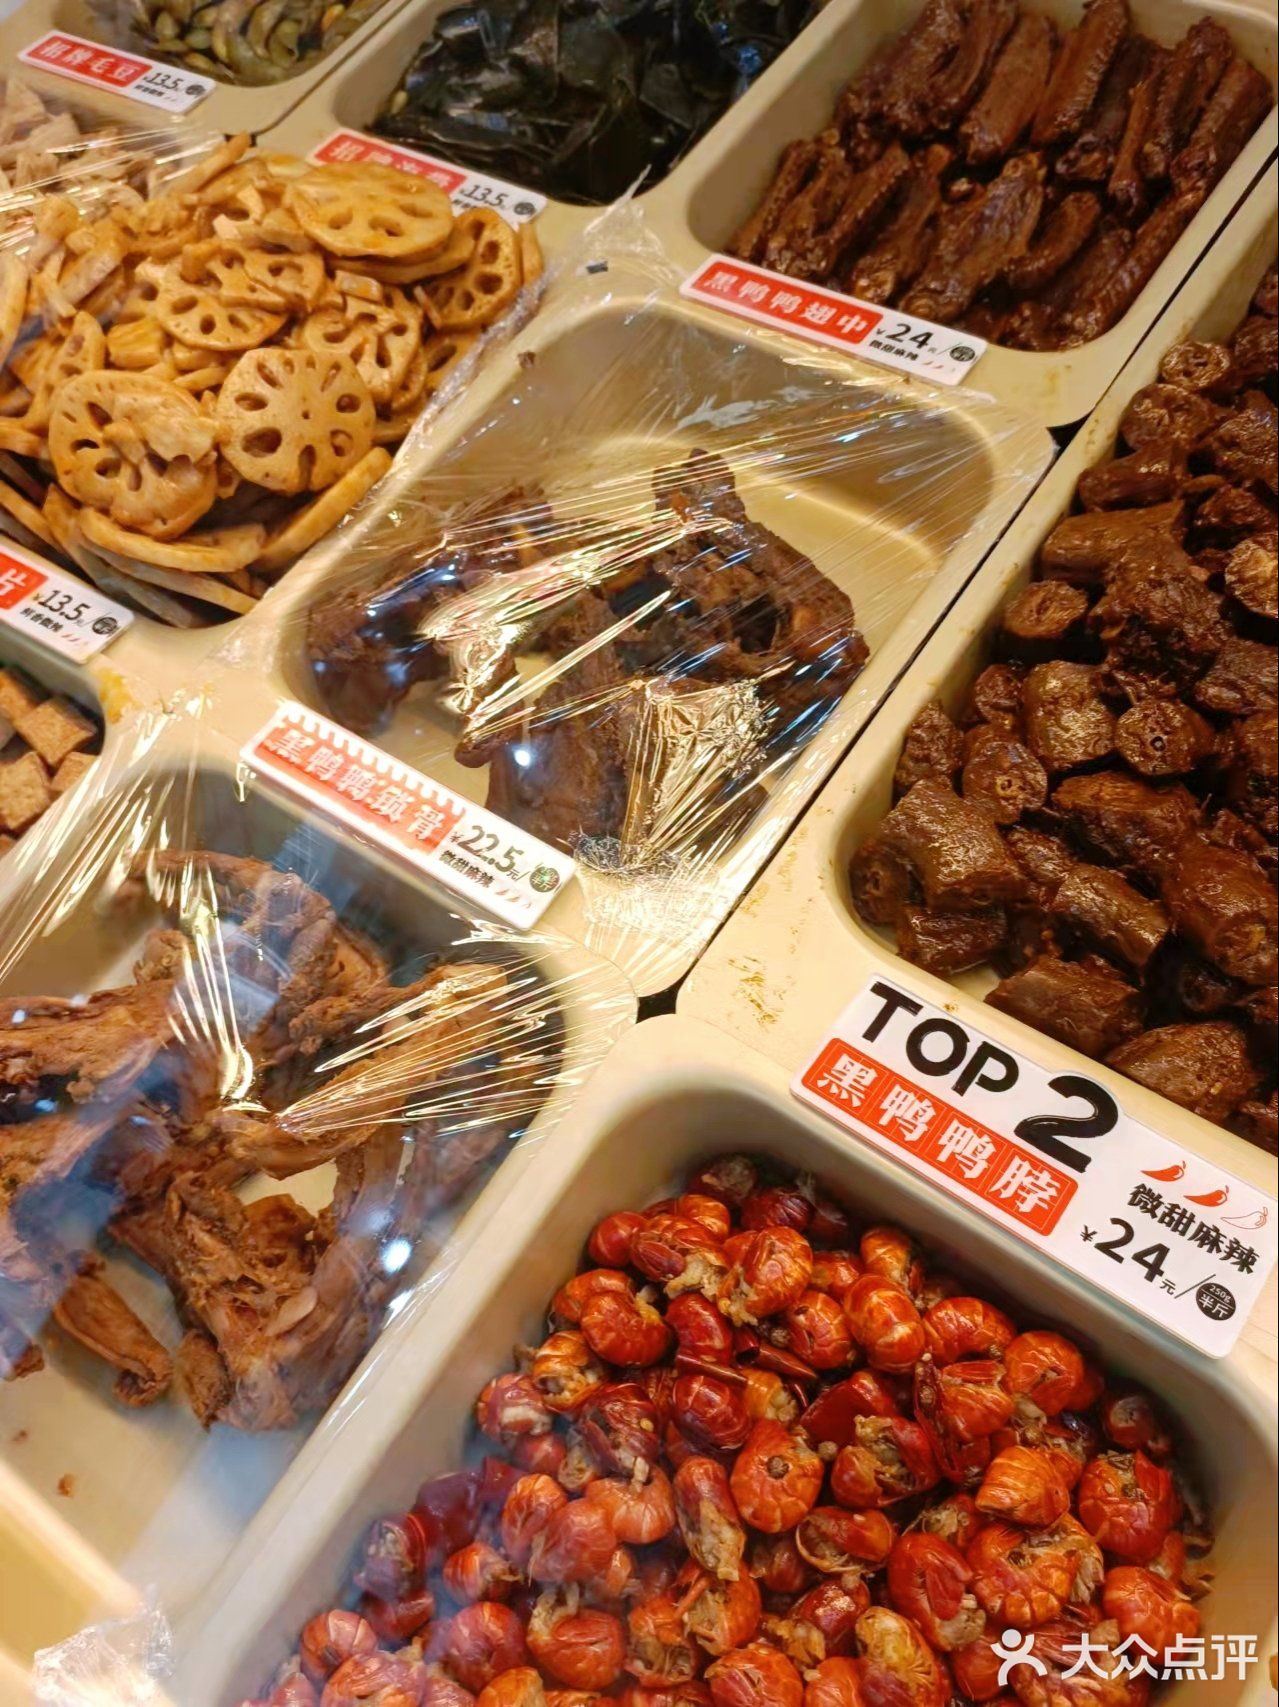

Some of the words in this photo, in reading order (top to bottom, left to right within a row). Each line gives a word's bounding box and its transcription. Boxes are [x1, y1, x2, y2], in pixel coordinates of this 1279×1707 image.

[704, 271, 868, 335] 黑鸭鸭翅中
[869, 339, 919, 361] 微甜麻辣
[266, 728, 446, 841] 黑鸭鸭锁骨
[439, 850, 495, 888] 微甜麻辣
[862, 981, 1019, 1097] TOP
[1014, 1076, 1119, 1173] 2
[816, 1053, 1065, 1214] 黑鸭鸭脖
[1128, 1183, 1260, 1275] 微甜麻辣
[1198, 1293, 1230, 1318] 半斤
